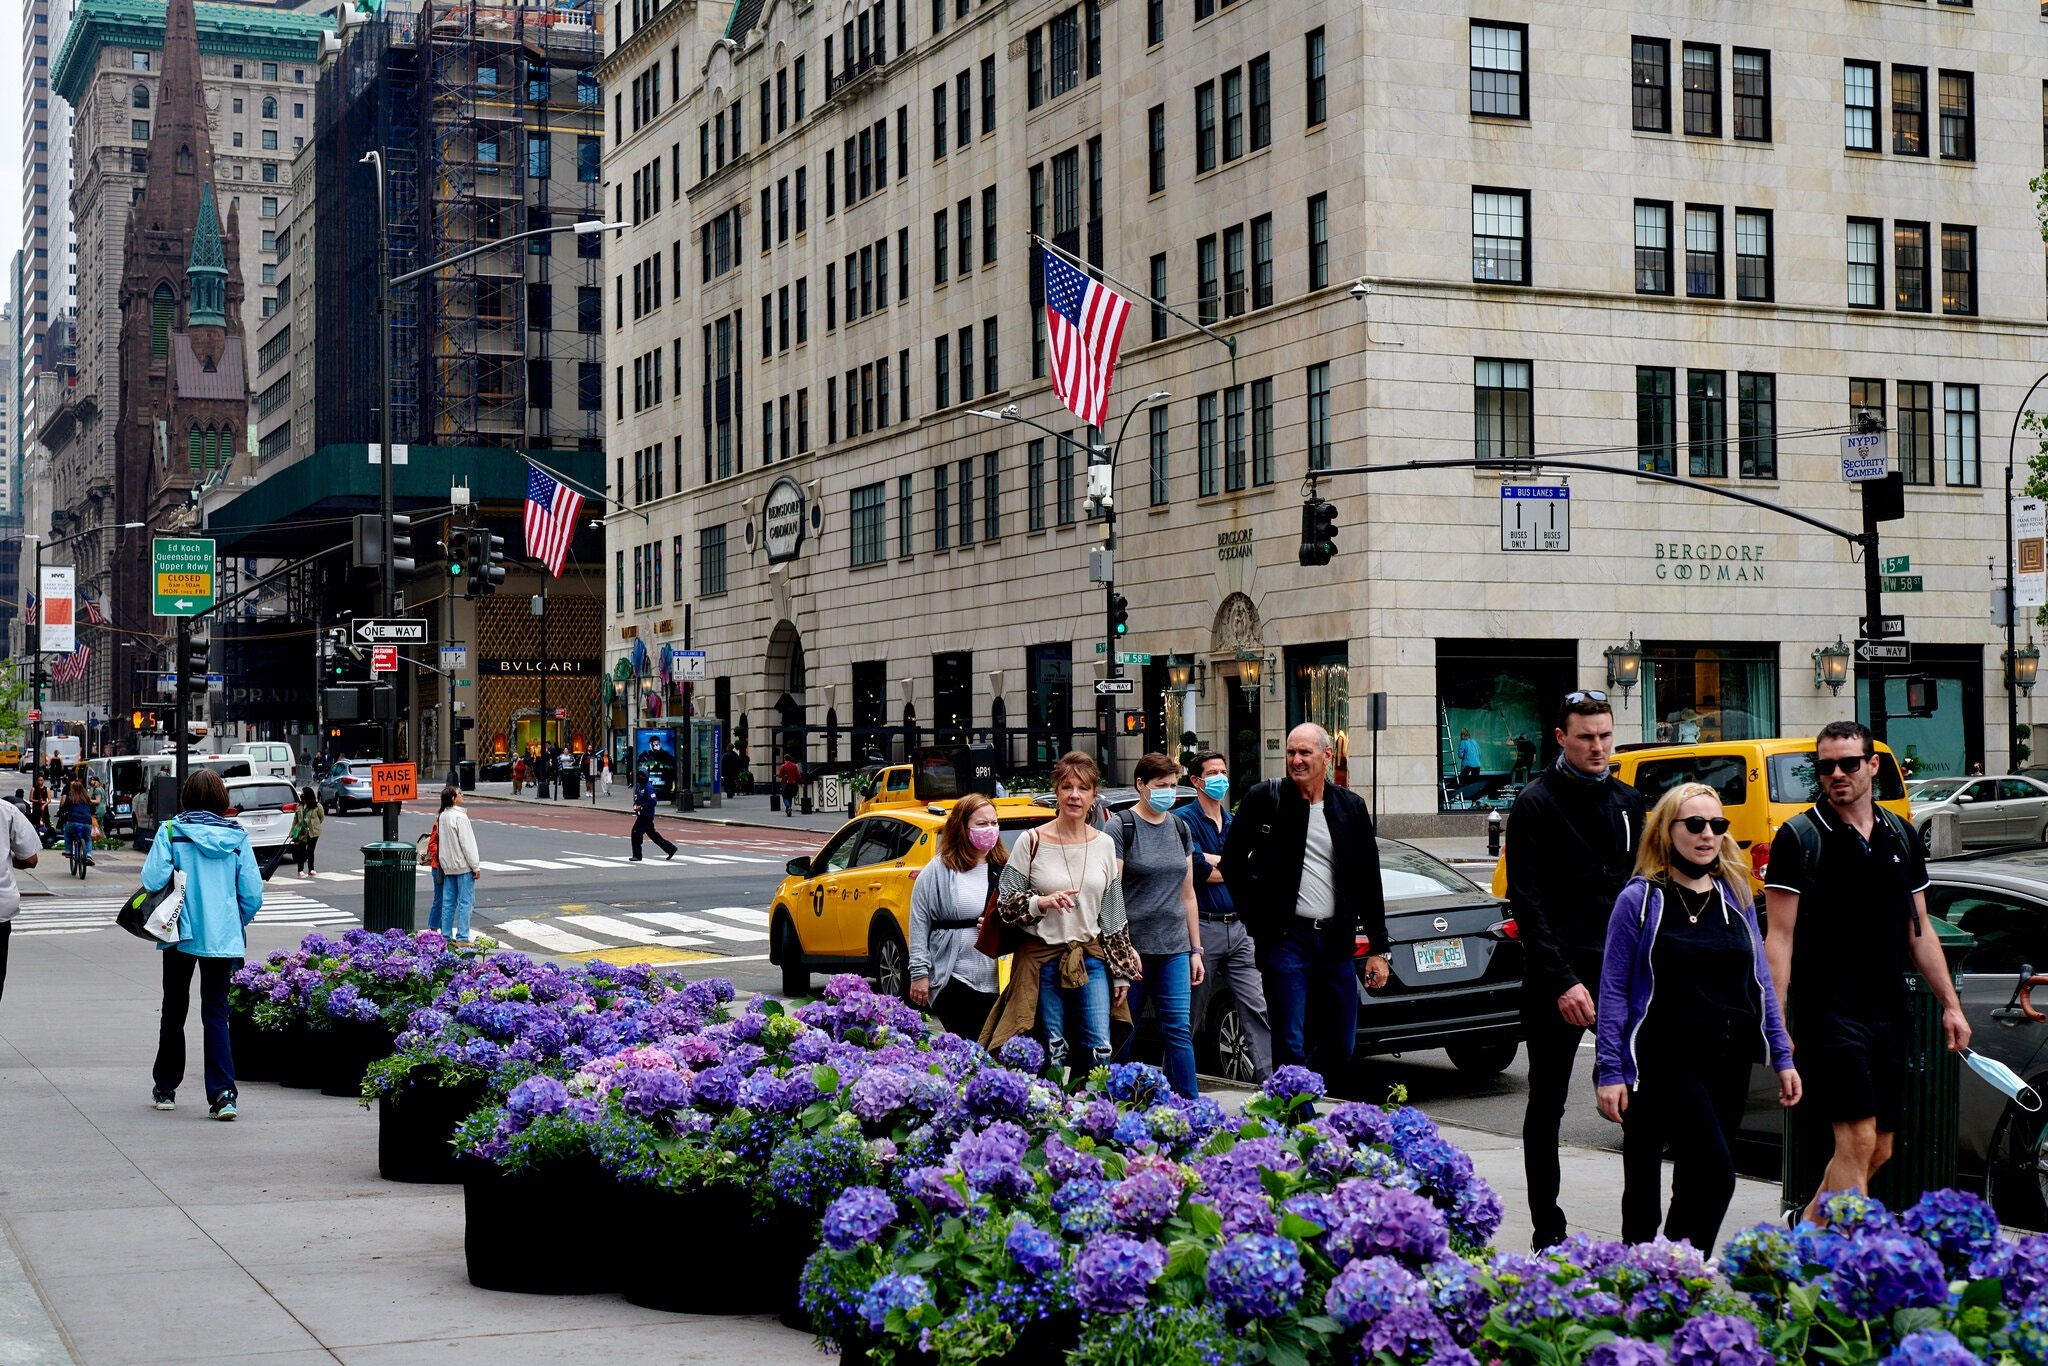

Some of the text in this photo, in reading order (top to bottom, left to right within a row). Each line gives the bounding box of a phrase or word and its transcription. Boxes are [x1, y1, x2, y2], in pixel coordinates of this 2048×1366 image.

[1847, 436, 1879, 448] NYPD
[1843, 458, 1885, 468] SECURITY
[1845, 468, 1884, 478] CAMERA
[1517, 488, 1530, 496] BUS
[768, 501, 799, 520] BERGDORF
[769, 520, 798, 540] GOODMAN
[1218, 528, 1253, 546] BERGDORF
[1655, 543, 1764, 560] BERGDORF
[160, 563, 208, 572] Upper Rdwy
[1889, 559, 1895, 572] 5
[1655, 564, 1764, 581] GOODMAN
[1890, 578, 1897, 590] W
[1901, 578, 1912, 590] 58
[364, 627, 417, 636] ONE WAY
[1884, 622, 1898, 631] WAY
[1862, 647, 1903, 656] ONE WAY
[149, 712, 155, 727] 5
[1140, 716, 1145, 729] 5
[377, 770, 411, 782] RAISE
[976, 766, 990, 777] 9P81
[380, 784, 410, 796] PLOW
